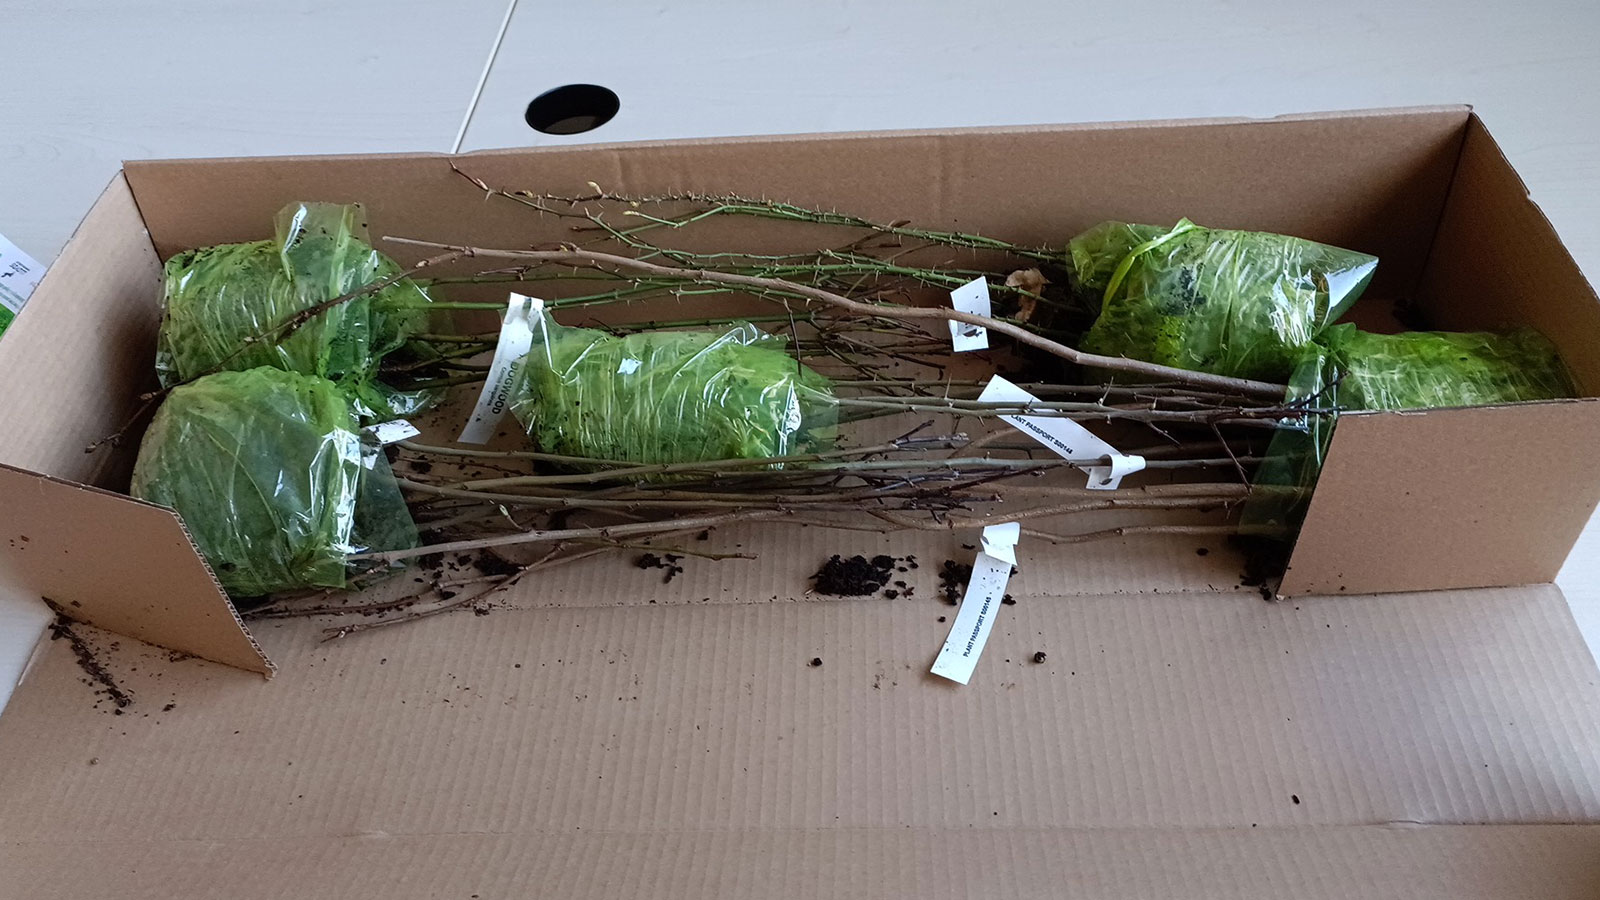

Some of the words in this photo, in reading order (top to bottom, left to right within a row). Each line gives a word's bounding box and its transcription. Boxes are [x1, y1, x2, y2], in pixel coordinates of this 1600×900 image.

[492, 361, 519, 414] DOGWOOD
[1025, 421, 1055, 442] PASSPORT
[963, 641, 974, 657] PLANT
[970, 615, 984, 641] PASSPORT
